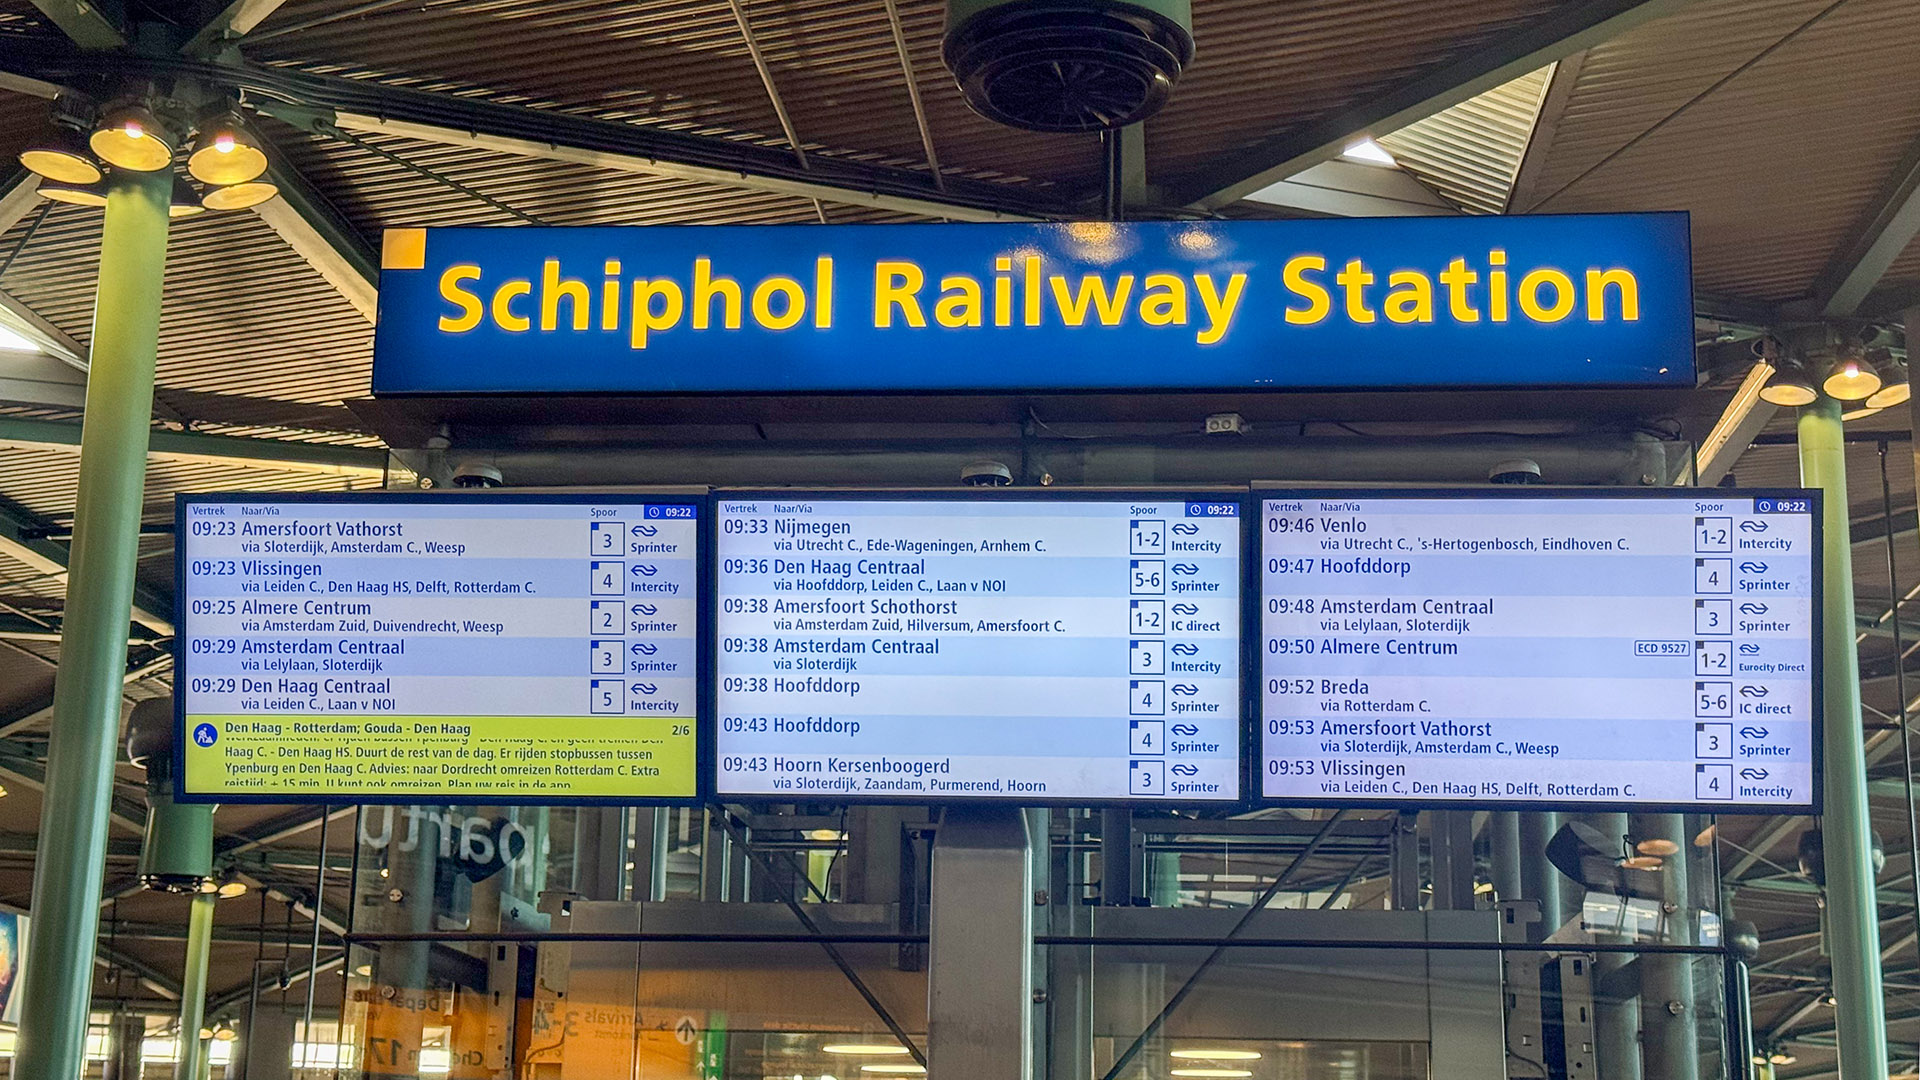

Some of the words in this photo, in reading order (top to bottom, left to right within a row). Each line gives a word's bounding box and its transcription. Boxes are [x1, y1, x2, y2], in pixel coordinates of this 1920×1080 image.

[439, 257, 833, 349] Schiphol
[875, 254, 1247, 345] Railway
[1283, 250, 1639, 324] Station
[192, 506, 225, 515] Vertrek
[242, 506, 280, 515] Naar/Via
[591, 507, 617, 518] Spoor
[666, 508, 691, 517] 09:22
[724, 503, 757, 513] Vertrek
[774, 503, 812, 513] Naar/Via
[1130, 505, 1157, 516] Spoor
[1207, 505, 1234, 515] 09:22
[1269, 502, 1303, 511] Vertrek
[1320, 502, 1360, 511] Naar/Via
[1695, 502, 1724, 514] Spoor
[1777, 502, 1805, 512] 09:22
[724, 519, 768, 534] 09:33
[775, 518, 850, 538] Nijmegen
[1269, 518, 1314, 533] 09:46
[1320, 516, 1366, 533] Venlo
[1136, 532, 1160, 546] 1-2
[1702, 529, 1726, 544] 1-2
[1739, 537, 1792, 551] Intercity
[774, 538, 792, 550] via
[797, 538, 843, 551] Utrecht
[847, 539, 862, 553] C.,
[867, 538, 977, 555] Ede-Wageningen,
[980, 539, 1030, 552] Arnhem
[1035, 540, 1046, 552] C.
[1172, 540, 1221, 554] Intercity
[1320, 537, 1339, 550] via
[1344, 537, 1393, 550] Utrecht
[1397, 538, 1413, 551] C.,
[1418, 537, 1537, 553] 's-Hertogenbosch,
[1543, 537, 1612, 550] Eindhoven
[1617, 538, 1629, 550] C.
[192, 600, 235, 615] 09:25
[242, 599, 298, 615] Almere
[304, 600, 371, 615] Centrum
[724, 598, 768, 613] 09:38
[774, 598, 865, 614] Amersfoort
[871, 598, 957, 614] Schothorst
[1269, 599, 1314, 614] 09:48
[1320, 598, 1416, 614] Amsterdam
[1423, 598, 1493, 614] Centraal
[604, 613, 612, 627] 2
[631, 620, 677, 634] Sprinter
[773, 618, 792, 630] via
[795, 618, 868, 631] Amsterdam
[872, 618, 903, 633] Zuid,
[907, 618, 973, 633] Hilversum,
[977, 619, 1050, 632] Amersfoort
[1054, 620, 1065, 632] C.
[1136, 612, 1159, 627] 1-2
[1172, 621, 1183, 631] IC
[1186, 620, 1220, 631] direct
[1320, 618, 1339, 631] via
[1344, 618, 1401, 634] Lelylaan,
[1406, 618, 1470, 635] Sloterdijk
[1709, 612, 1718, 627] 3
[1739, 620, 1790, 634] Sprinter
[241, 619, 259, 631] via
[263, 619, 334, 631] Amsterdam
[339, 619, 369, 633] Zuid,
[373, 619, 459, 634] Duivendrecht,
[463, 621, 503, 636] Weesp
[724, 638, 768, 653] 09:38
[773, 637, 865, 653] Amsterdam
[872, 638, 939, 654] Centraal
[1269, 639, 1314, 654] 09:50
[1320, 638, 1380, 654] Almere
[1386, 639, 1457, 655] Centrum
[1638, 643, 1658, 653] ECD
[1661, 643, 1686, 653] 9527
[773, 657, 792, 670] via
[796, 657, 857, 673] Sloterdijk
[1143, 652, 1152, 667] 3
[1701, 653, 1727, 668] 1-2
[1171, 661, 1221, 675] Intercity
[1739, 663, 1775, 673] Eurocity
[1778, 663, 1805, 672] Direct
[192, 678, 235, 693] 09:29
[242, 678, 272, 693] Den
[279, 678, 318, 697] Haag
[324, 678, 390, 693] Centraal
[1269, 679, 1314, 694] 09:52
[1321, 678, 1369, 695] Breda
[241, 697, 259, 709] via
[264, 697, 304, 710] Leiden
[309, 698, 324, 712] C.,
[328, 698, 357, 710] Laan
[361, 701, 368, 710] v
[373, 698, 395, 710] NOI
[604, 692, 612, 706] 5
[631, 699, 679, 713] Intercity
[1320, 698, 1339, 711] via
[1344, 699, 1414, 712] Rotterdam
[1419, 700, 1431, 712] C.
[1701, 694, 1727, 710] 5-6
[1740, 703, 1751, 714] IC
[1755, 703, 1791, 714] direct
[226, 722, 248, 733] Den
[252, 722, 281, 736] Haag
[294, 722, 360, 734] Rotterdam;
[364, 722, 402, 733] Gouda
[414, 723, 437, 734] Den
[441, 723, 470, 737] Haag
[672, 725, 690, 736] 2/6
[1269, 720, 1314, 735] 09:53
[1320, 719, 1416, 736] Amersfoort
[1420, 720, 1491, 736] Vathorst
[1320, 739, 1340, 752] via
[1344, 740, 1411, 756] Sloterdijk,
[1415, 741, 1491, 754] Amsterdam
[1496, 742, 1512, 756] C.,
[1515, 742, 1559, 758] Weesp
[1709, 735, 1718, 751] 3
[225, 746, 253, 760] Haag
[257, 746, 267, 757] C.
[278, 747, 300, 757] Den
[304, 747, 332, 760] Haag
[336, 747, 352, 757] HS.
[356, 747, 387, 758] Duurt
[391, 746, 404, 758] de
[408, 748, 429, 758] rest
[432, 750, 452, 758] van
[456, 747, 469, 758] de
[473, 747, 496, 761] dag.
[500, 748, 511, 758] Er
[515, 747, 547, 762] rijden
[550, 748, 613, 762] stopbussen
[617, 749, 652, 760] tussen
[1740, 744, 1791, 758] Sprinter
[724, 757, 767, 772] 09:43
[774, 757, 822, 772] Hoorn
[828, 757, 949, 777] Kersenboogerd
[773, 776, 791, 789] via
[796, 777, 860, 792] Sloterdijk,
[864, 778, 926, 792] Zaandam,
[931, 779, 1003, 793] Purmerend,
[1008, 779, 1046, 792] Hoorn
[1143, 772, 1151, 787] 3
[1171, 781, 1219, 794] Sprinter
